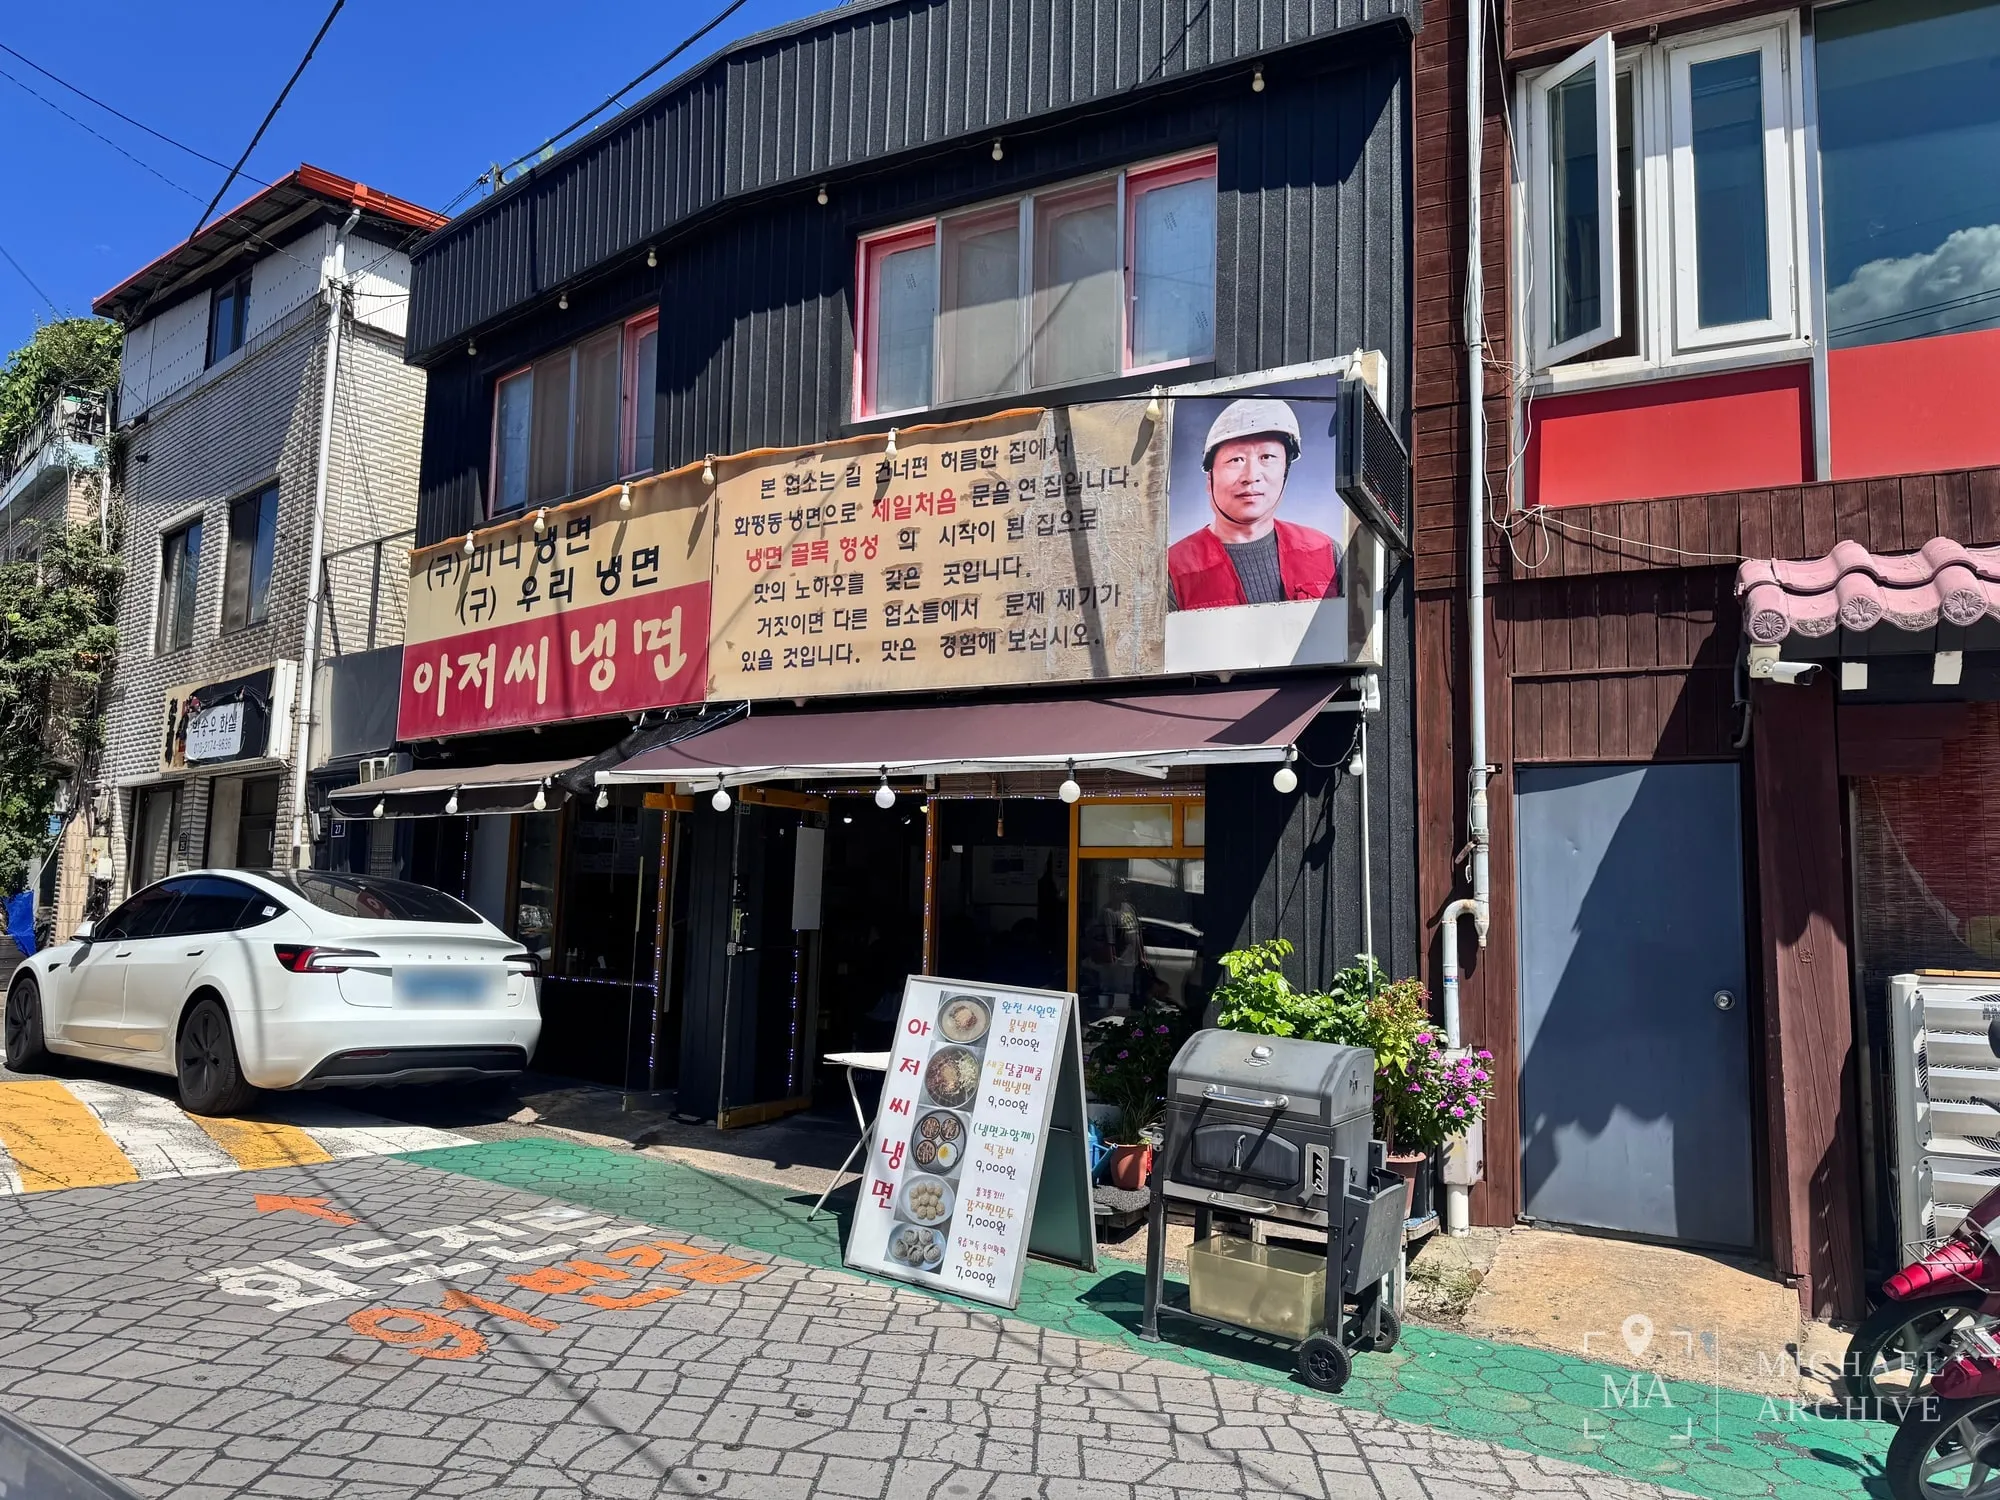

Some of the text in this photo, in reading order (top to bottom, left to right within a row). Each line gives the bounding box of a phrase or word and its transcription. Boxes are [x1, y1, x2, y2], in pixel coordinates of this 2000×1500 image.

[760, 479, 775, 499] 본
[785, 470, 835, 497] 업소는
[845, 466, 861, 488] 길
[941, 445, 998, 473] 허름한
[1009, 434, 1068, 464] 집에서
[972, 481, 1010, 508] 문을
[1018, 477, 1036, 500] 연
[899, 529, 916, 551] 의
[939, 521, 995, 547] 시작이
[1007, 518, 1025, 540] 된
[1036, 509, 1097, 537] 집으로
[754, 557, 1031, 603] 맛의 노하우를 갖은 곳입니다.
[460, 586, 496, 625] (구)
[517, 567, 574, 612] 우리
[757, 584, 1121, 638] 거짓이면 다른 업소들에서 문제 제기가
[741, 623, 1100, 672] 있을 것입니다. 맛은 경험해 보십시오.
[1000, 1035, 1039, 1052] 9,000원
[993, 1078, 1031, 1095] 비빔냉면
[988, 1095, 1028, 1114] 9,000원
[976, 1160, 1016, 1180] 9,000원
[966, 1214, 1006, 1236] 7,000원
[955, 1265, 996, 1288] 7,000원
